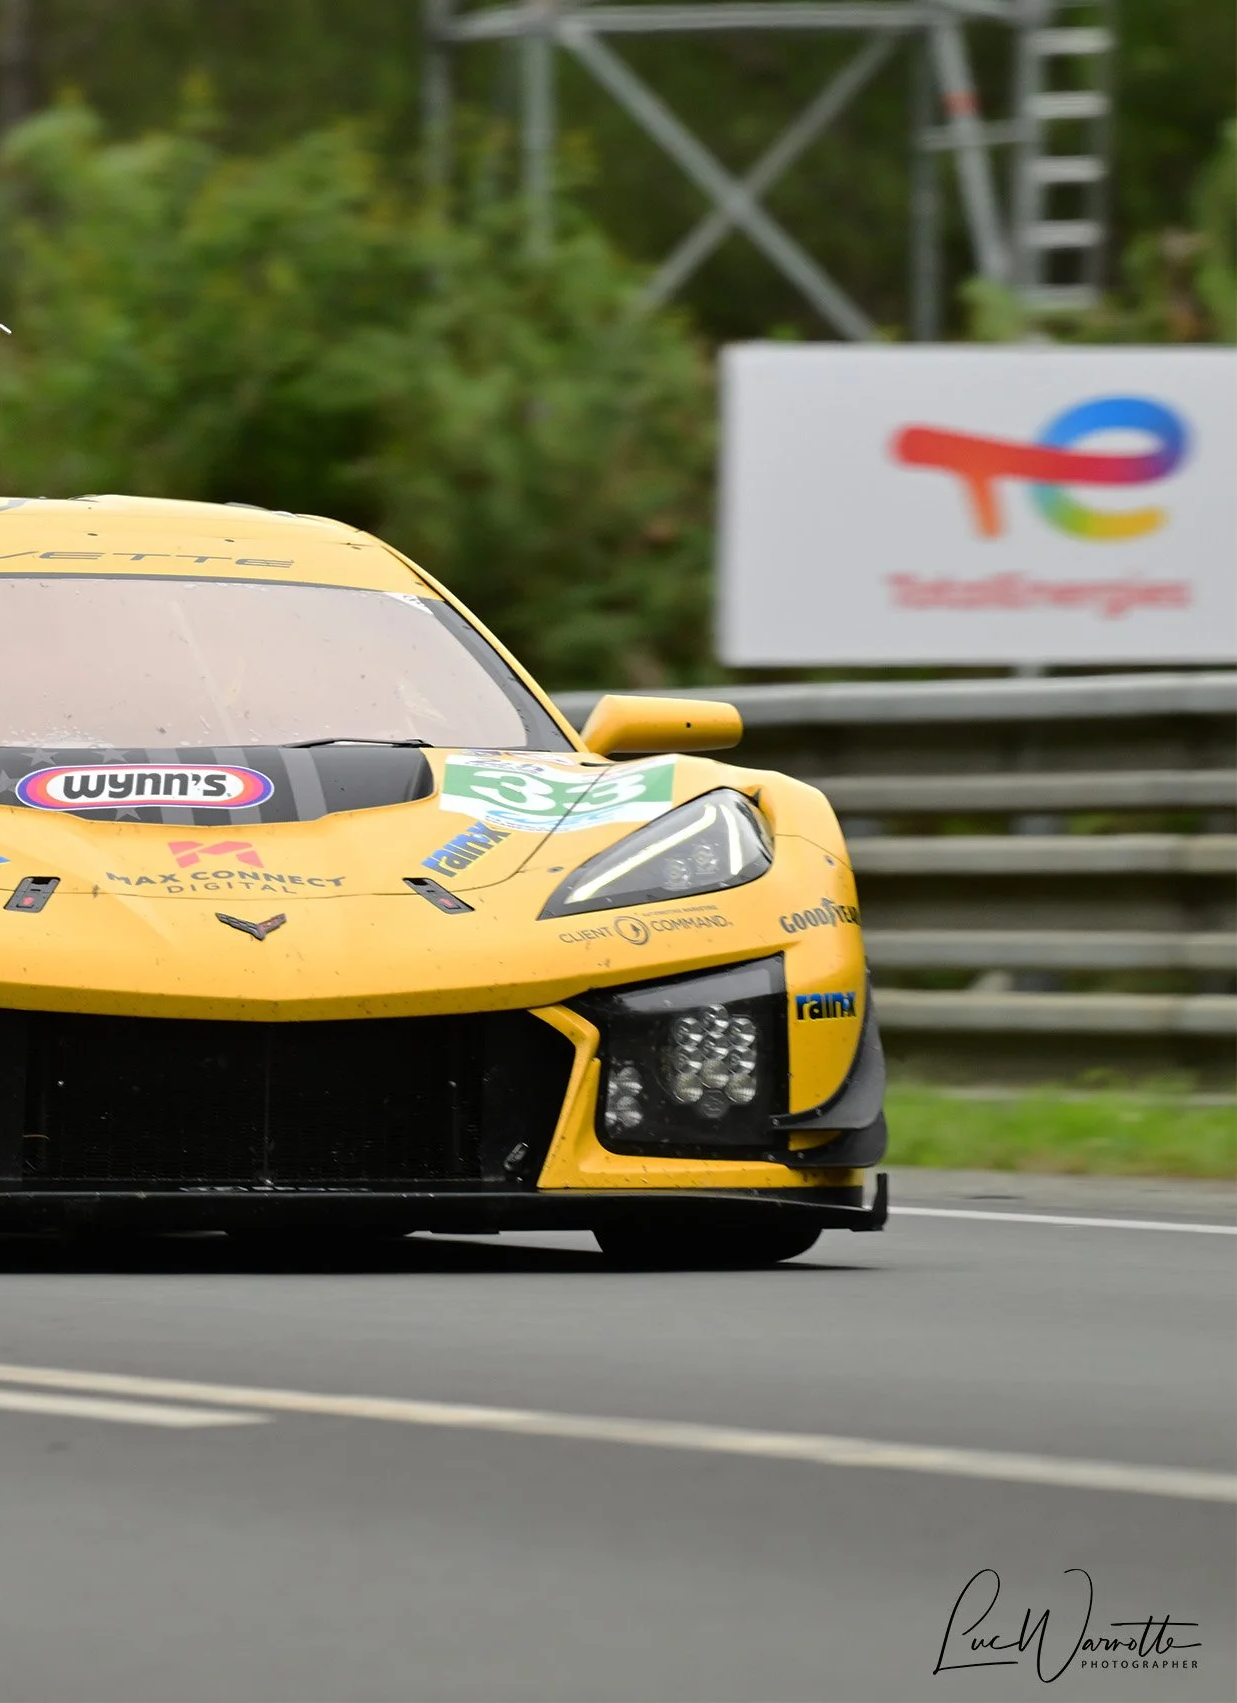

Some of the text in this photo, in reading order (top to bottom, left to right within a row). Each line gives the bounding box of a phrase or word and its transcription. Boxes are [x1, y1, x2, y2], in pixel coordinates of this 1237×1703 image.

[460, 770, 647, 812] 33
[106, 869, 346, 888] MAX CONNECT
[167, 881, 297, 895] DIGITAL
[558, 927, 613, 944] CLIENT
